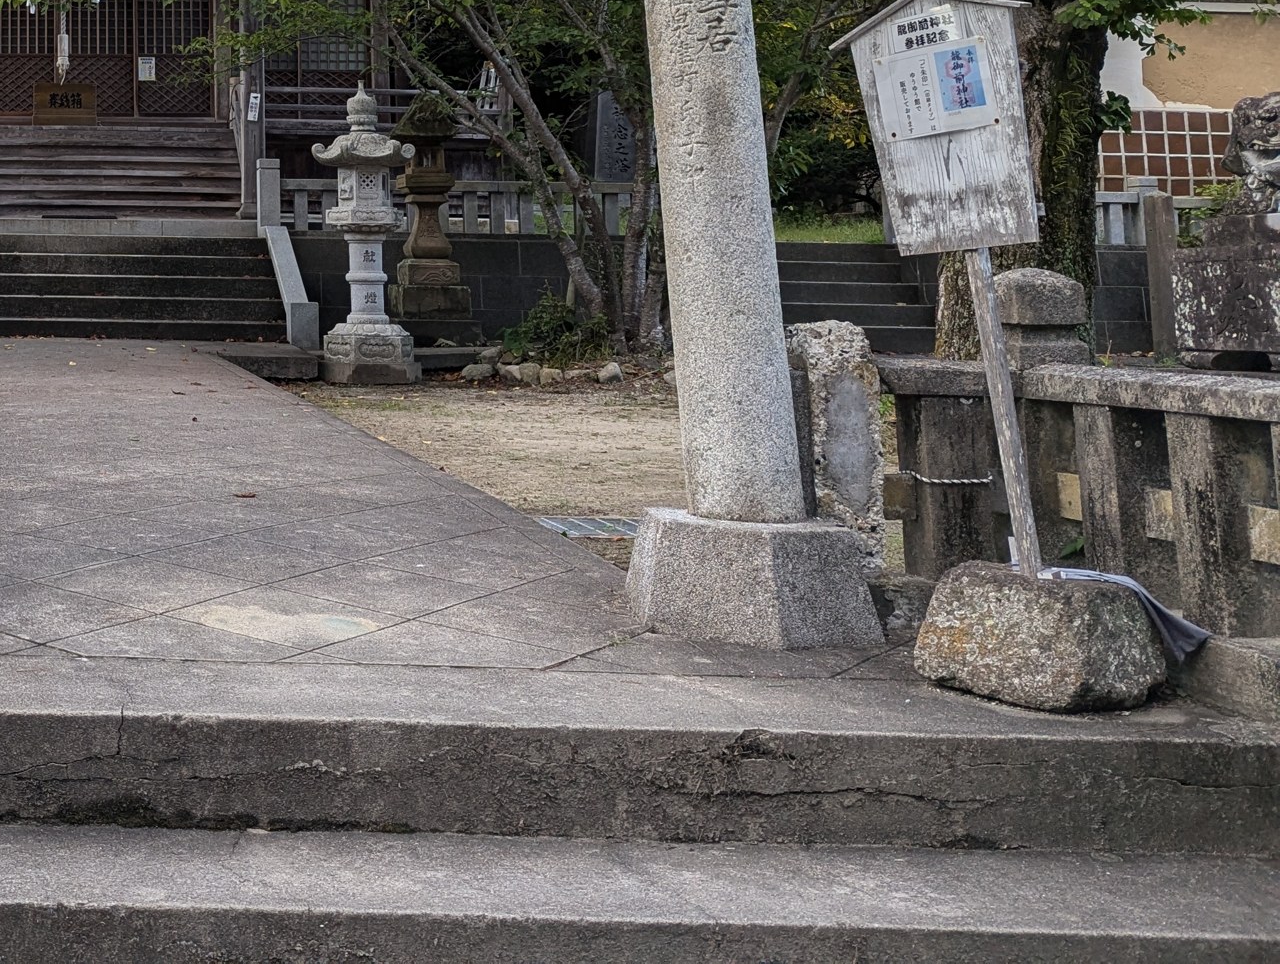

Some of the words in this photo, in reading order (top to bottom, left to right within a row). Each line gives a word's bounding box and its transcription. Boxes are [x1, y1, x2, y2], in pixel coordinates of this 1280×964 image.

[897, 14, 954, 36] 龍御前神社
[950, 50, 972, 109] 龍御前神社
